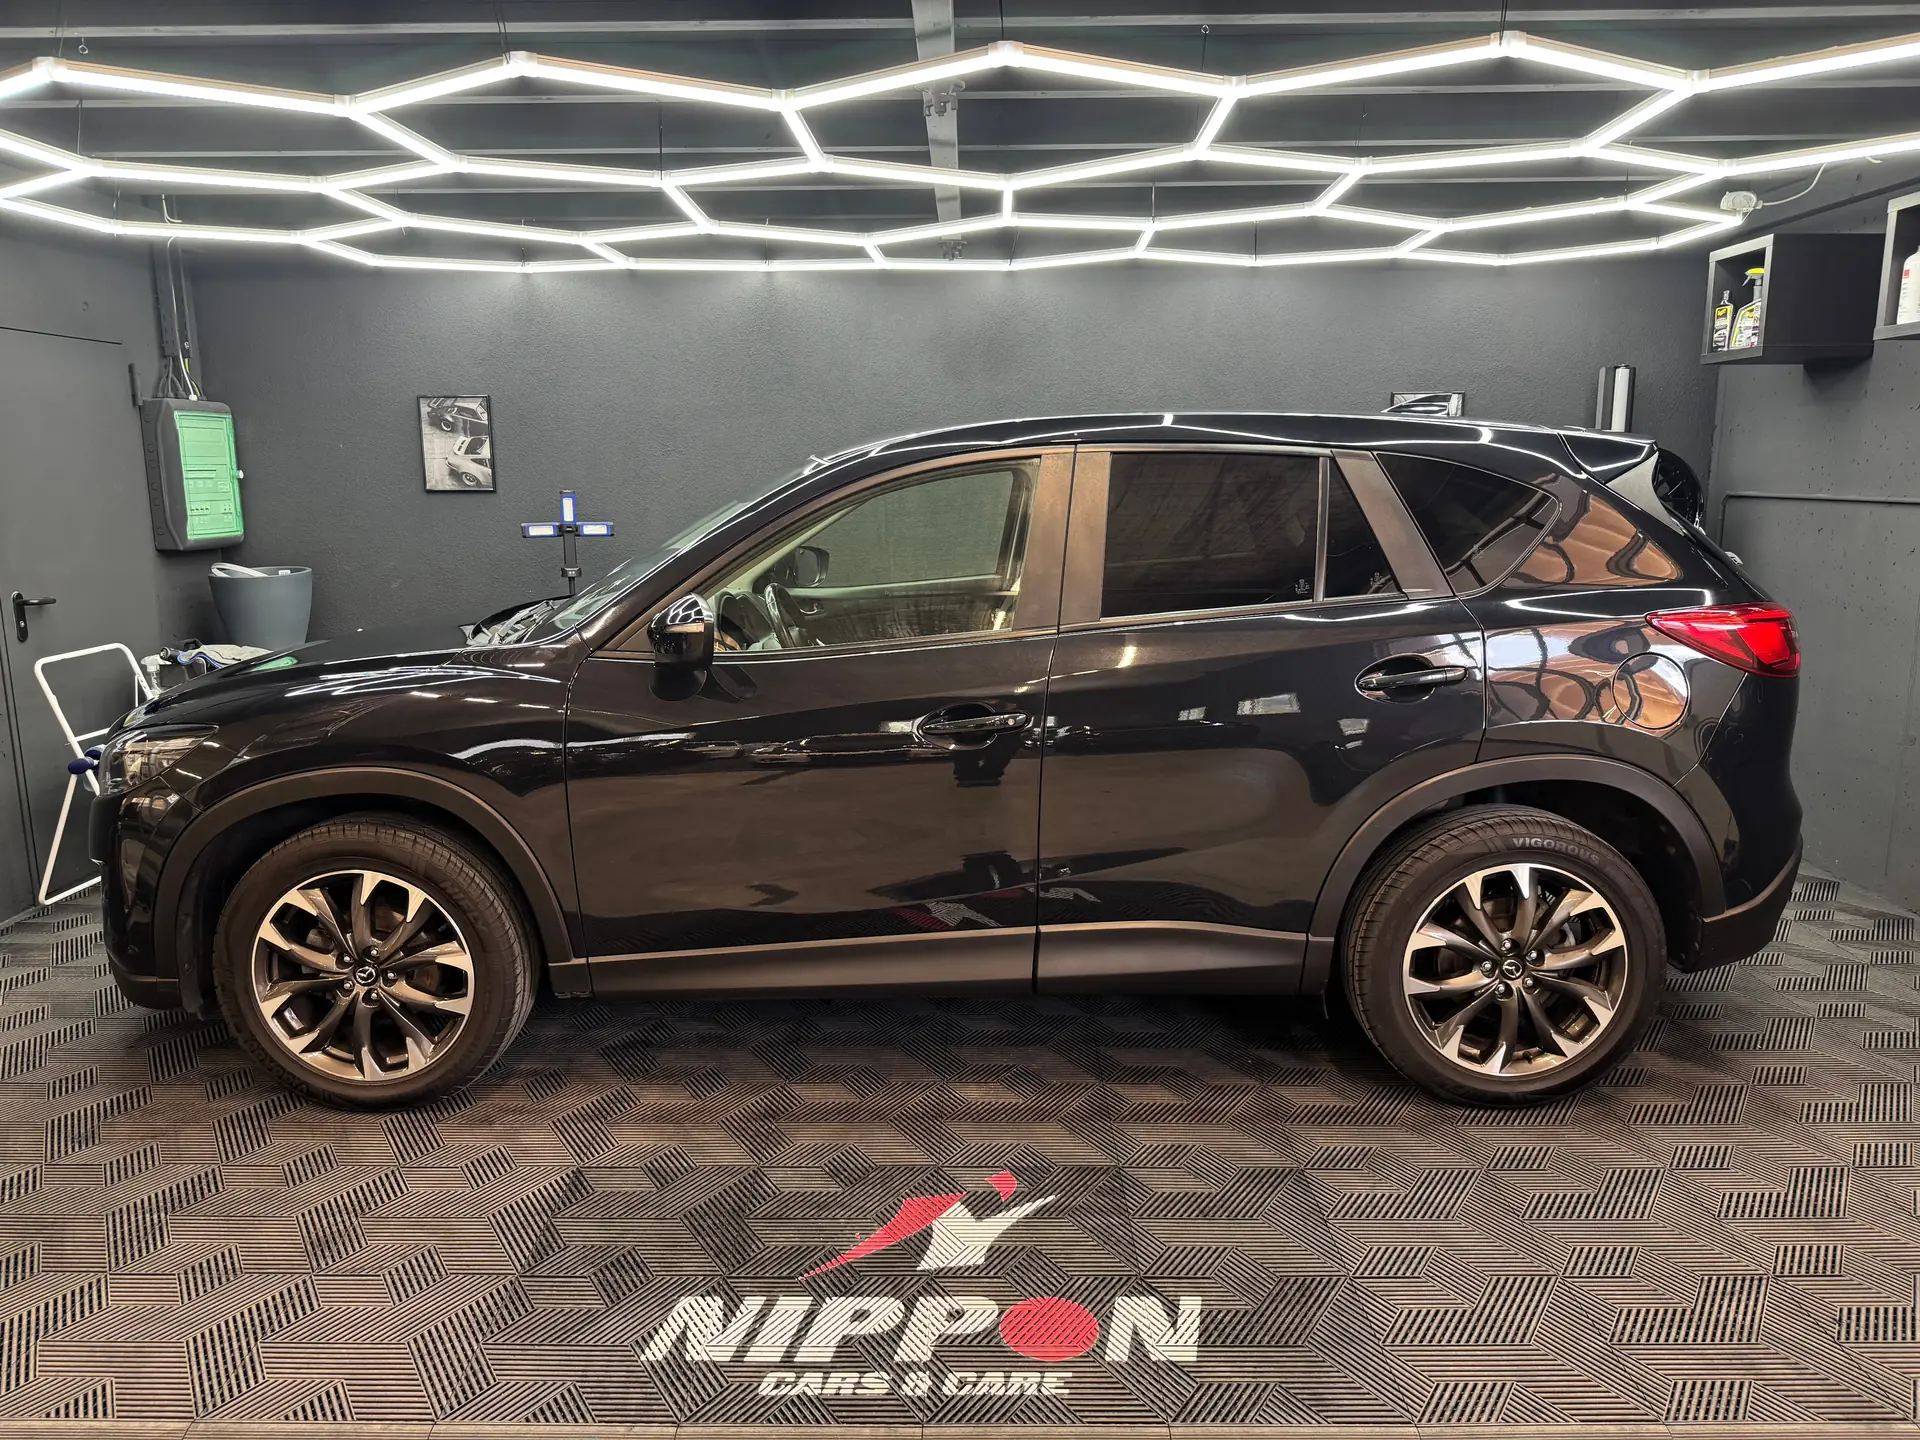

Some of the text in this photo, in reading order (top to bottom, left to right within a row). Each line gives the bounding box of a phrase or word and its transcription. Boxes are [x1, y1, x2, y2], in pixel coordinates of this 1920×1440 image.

[1512, 837, 1600, 864] VIGOROUS
[641, 1296, 1203, 1362] NIPPON
[758, 1371, 893, 1396] CARS
[941, 1371, 1074, 1396] CARE
